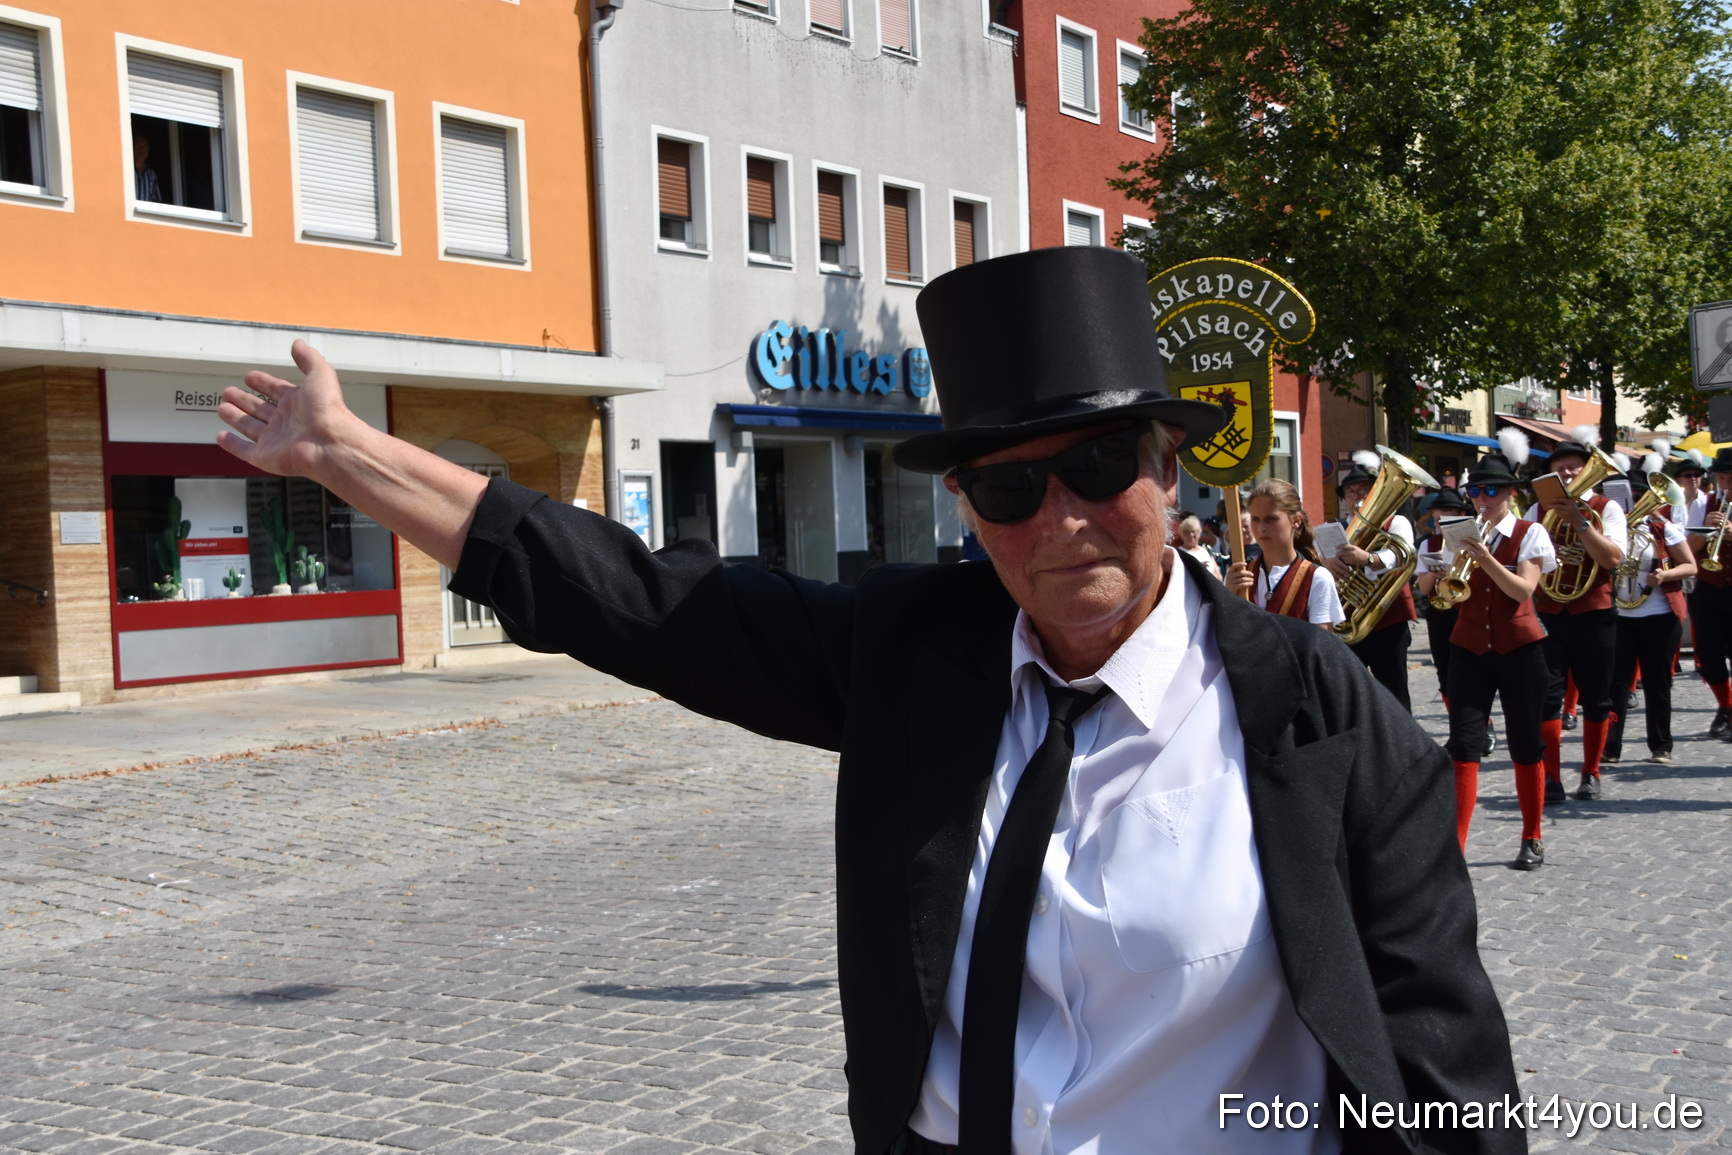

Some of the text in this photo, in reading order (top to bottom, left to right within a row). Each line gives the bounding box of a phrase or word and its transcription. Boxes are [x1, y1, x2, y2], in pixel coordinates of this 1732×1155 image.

[1157, 314, 1265, 363] Pilsach
[749, 319, 897, 395] Eilles
[1191, 351, 1233, 373] 1954
[630, 438, 640, 450] 31
